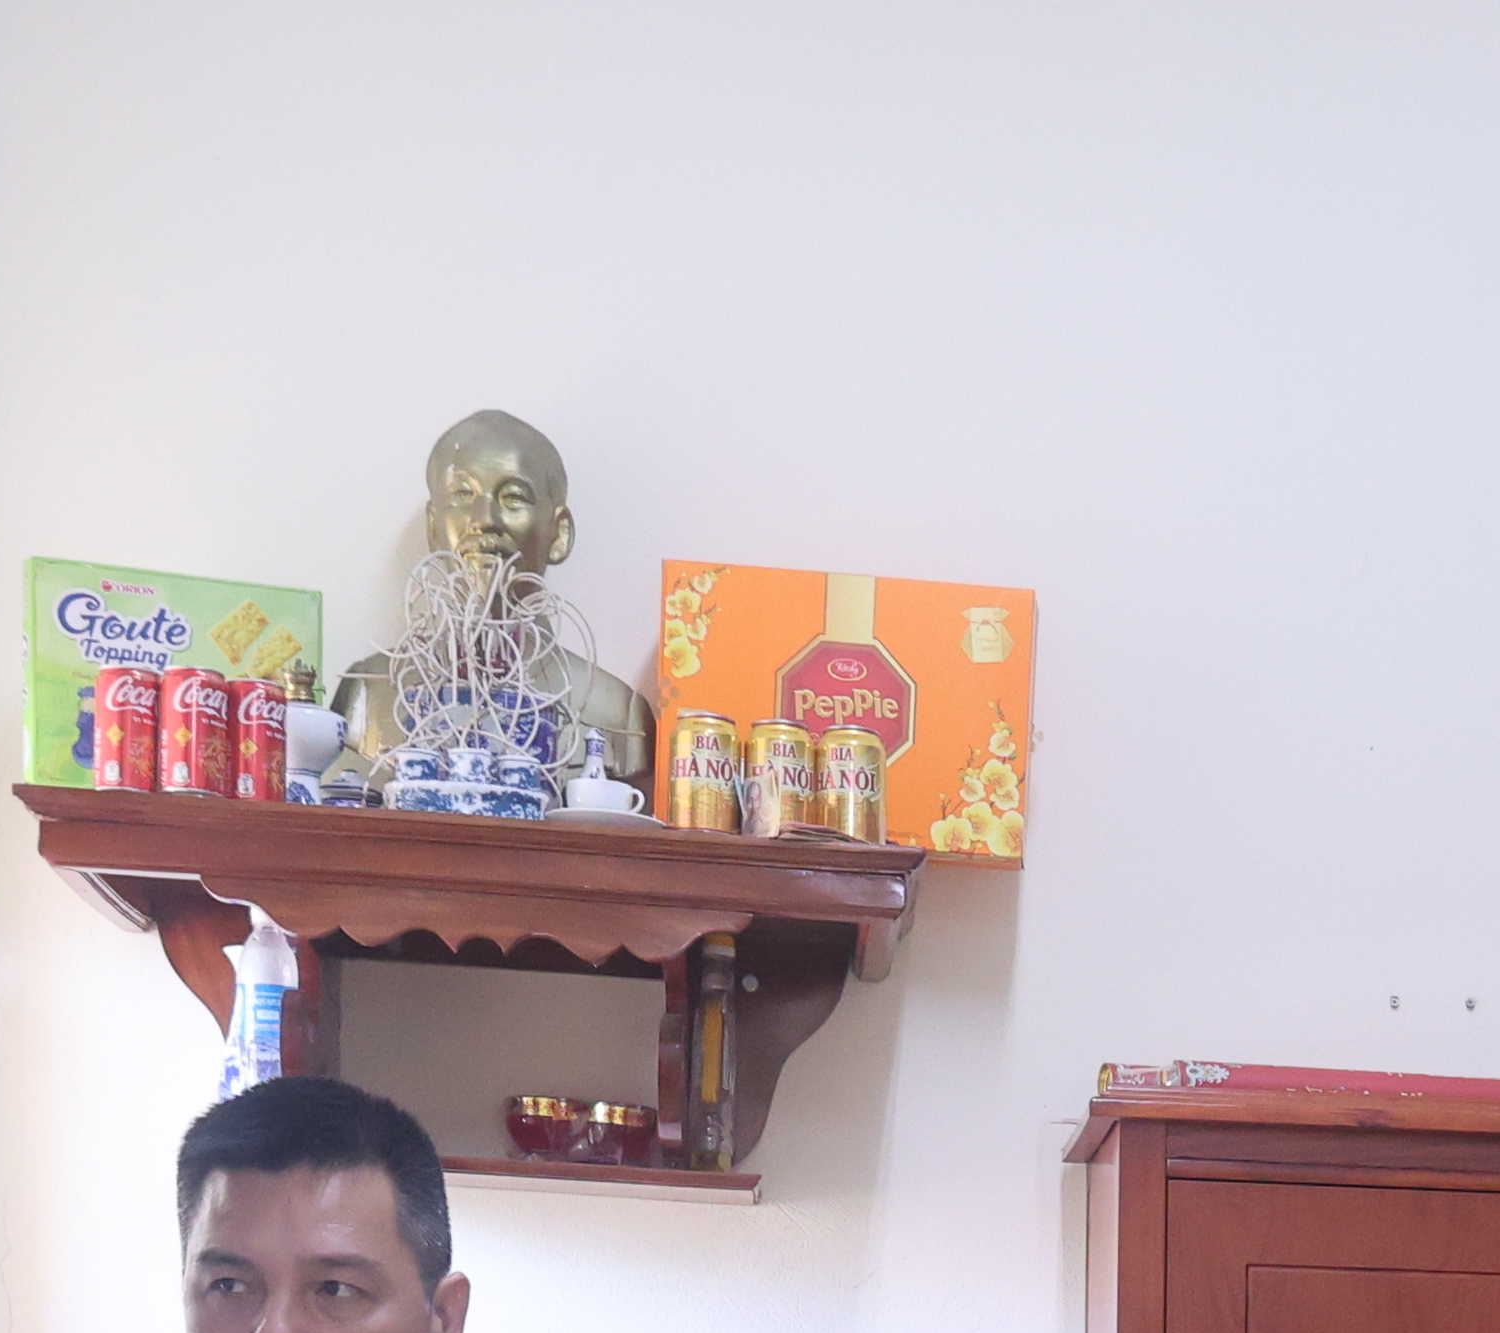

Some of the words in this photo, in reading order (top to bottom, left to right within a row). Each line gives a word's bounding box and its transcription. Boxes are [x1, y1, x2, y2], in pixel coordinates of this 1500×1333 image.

[57, 592, 187, 646] Gouté
[80, 639, 168, 670] Topping
[695, 735, 720, 751] BIA
[772, 742, 797, 759] BIA
[830, 745, 854, 761] BIA
[675, 752, 701, 777] HÀ
[838, 765, 876, 795] NỘI
